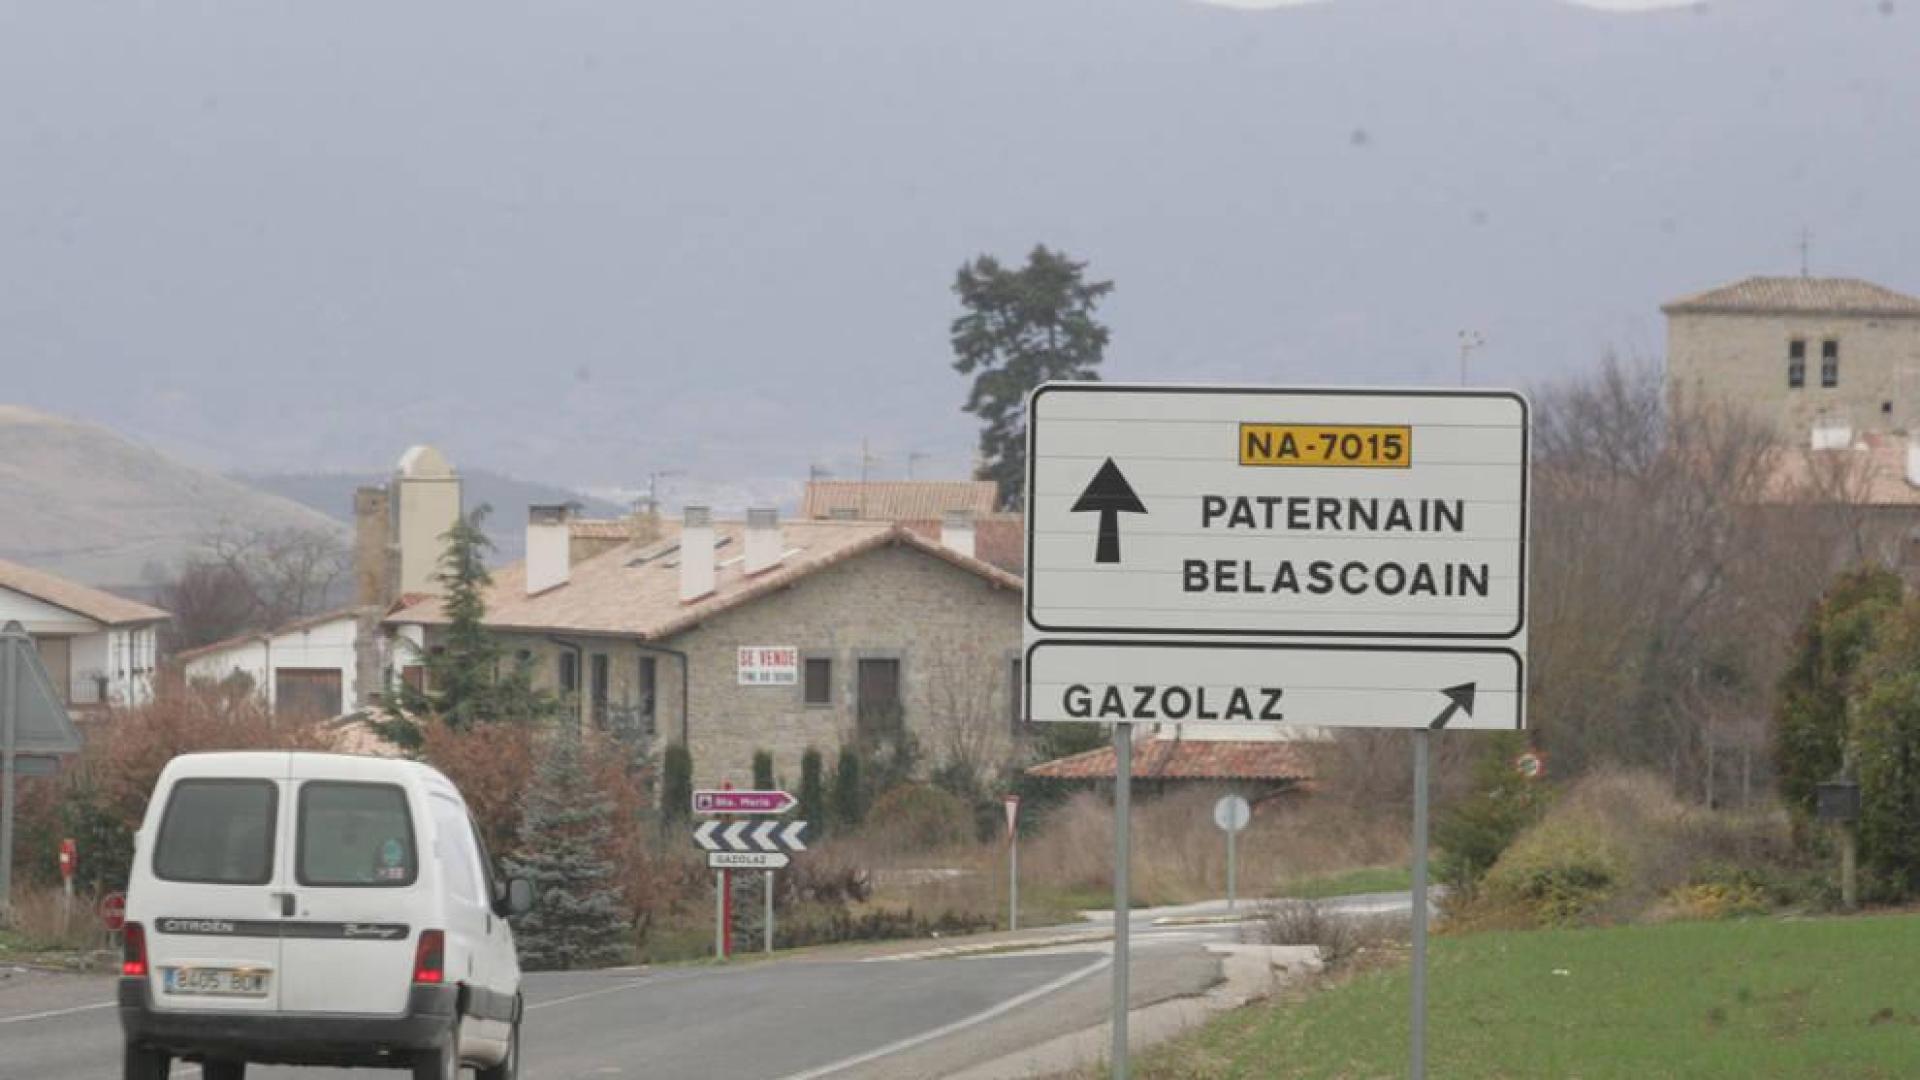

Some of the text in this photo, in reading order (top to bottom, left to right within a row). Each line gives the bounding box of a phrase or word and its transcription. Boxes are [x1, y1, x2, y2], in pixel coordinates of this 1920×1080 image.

[1246, 432, 1403, 460] NA-7015
[1202, 495, 1464, 532] PATERNAIN
[1183, 559, 1489, 597] BELASCOAIN
[740, 649, 795, 667] SE VENDE
[1063, 683, 1283, 720] GAZOLAZ
[717, 854, 767, 864] GAZOLAZ
